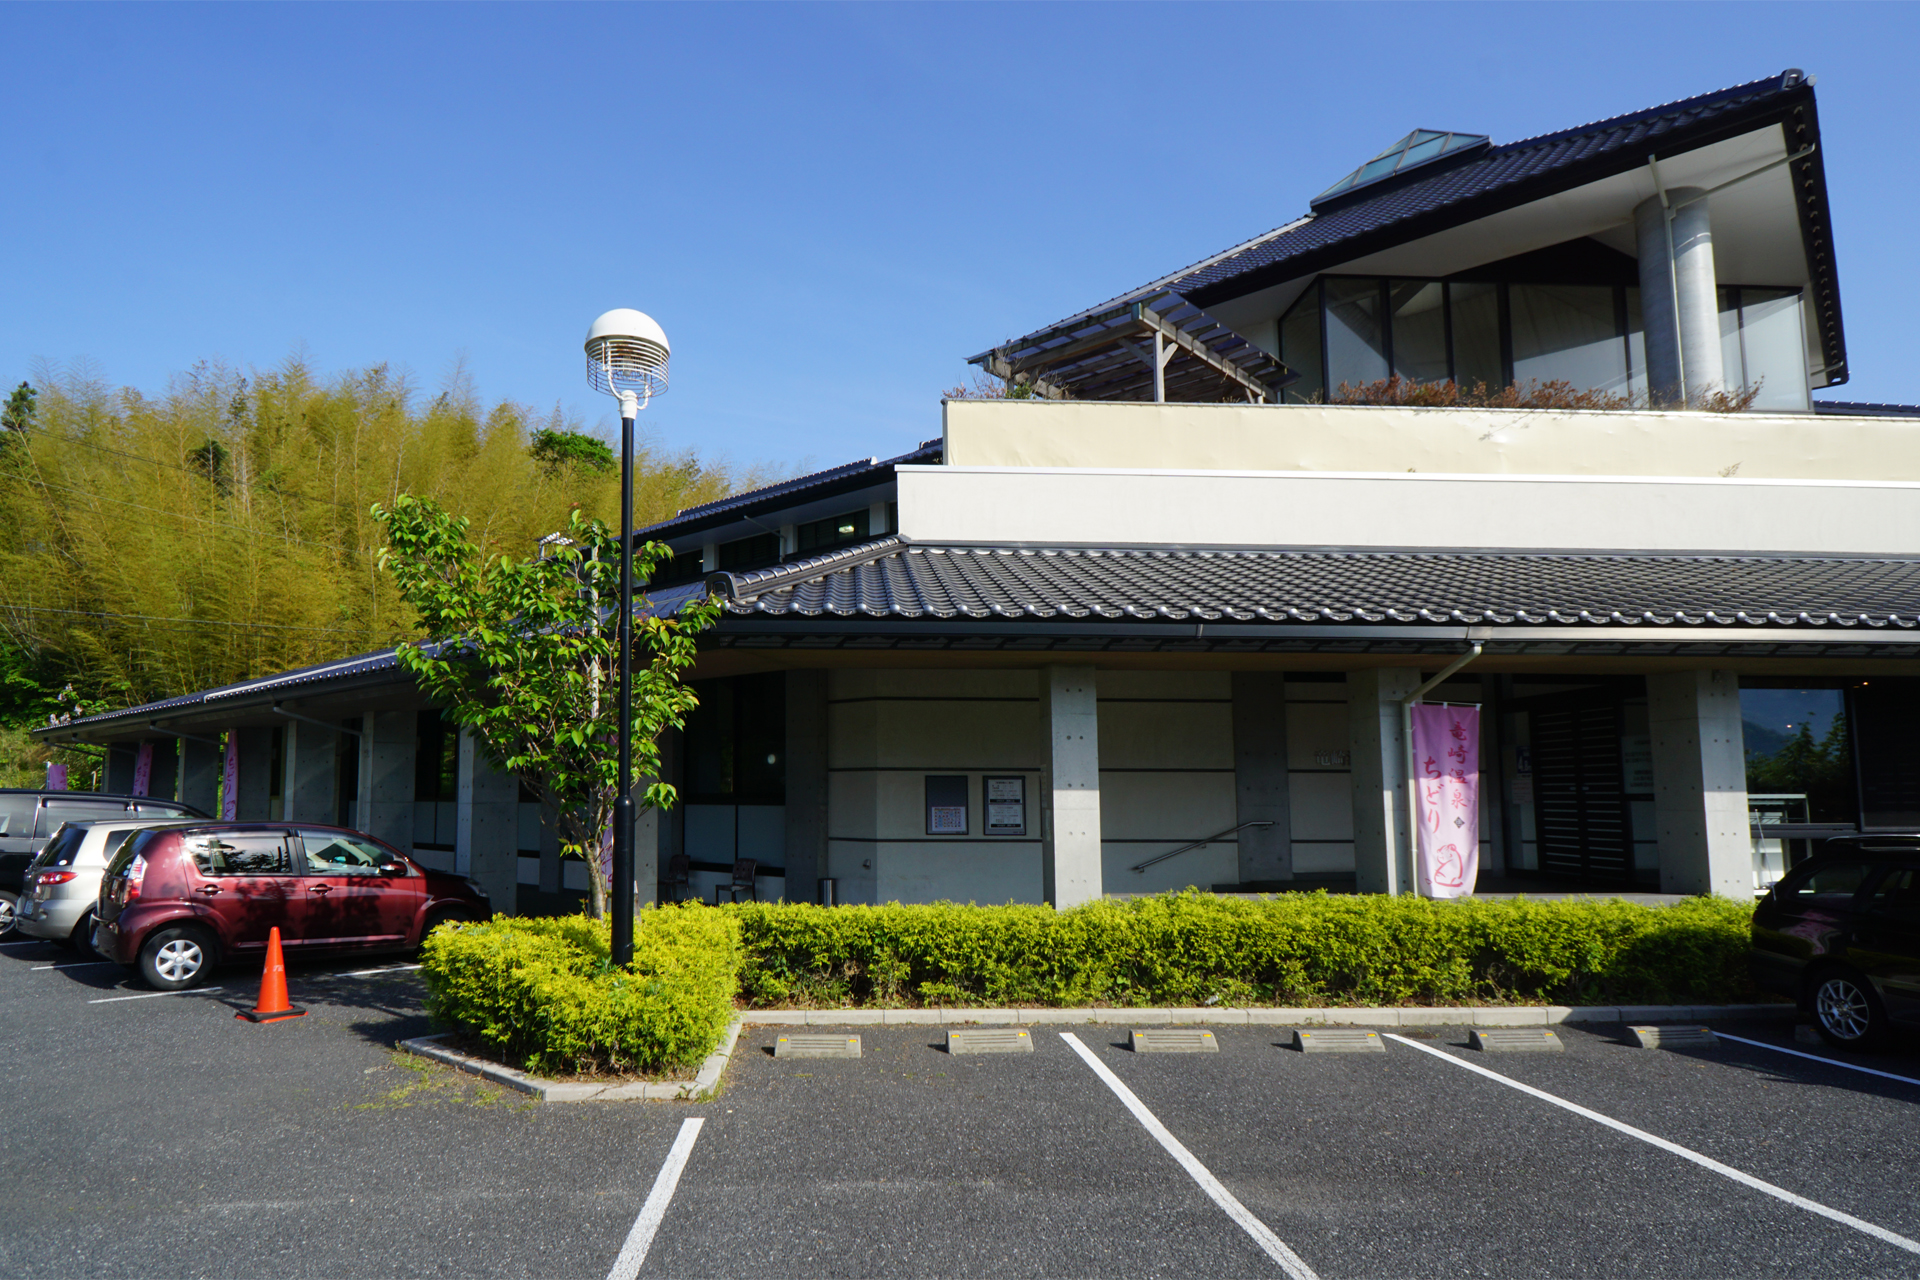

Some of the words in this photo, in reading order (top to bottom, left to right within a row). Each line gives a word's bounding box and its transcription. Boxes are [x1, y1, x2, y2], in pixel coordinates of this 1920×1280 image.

[1423, 755, 1444, 834] ちどり
[1447, 721, 1468, 809] 竜崎温泉
